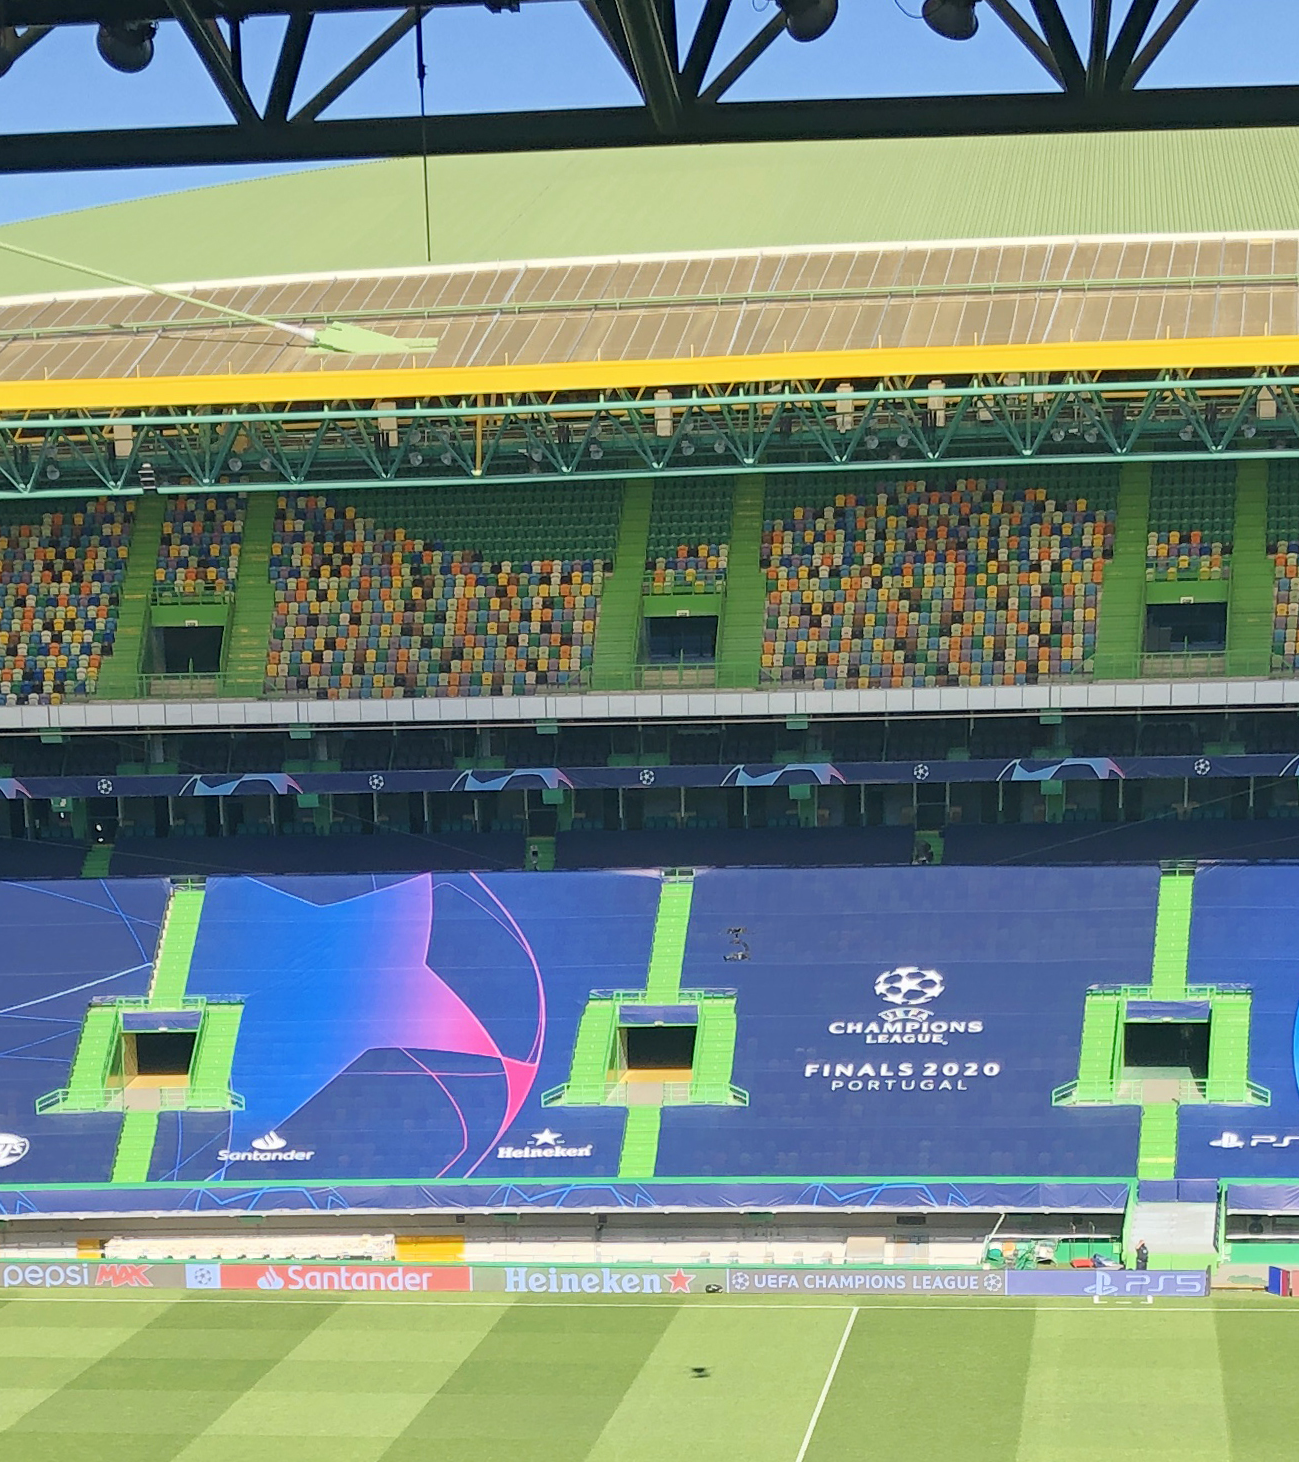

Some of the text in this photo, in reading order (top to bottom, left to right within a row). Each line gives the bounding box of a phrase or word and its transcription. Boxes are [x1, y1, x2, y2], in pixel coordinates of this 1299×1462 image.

[828, 1020, 984, 1034] CHAMPIONS
[865, 1034, 943, 1044] LEAGUE
[804, 1062, 1000, 1077] FINALS 2020
[831, 1079, 967, 1091] PORTUGAL
[217, 1150, 315, 1161] Santander
[497, 1146, 592, 1159] Heineken
[3, 1263, 154, 1288] pepsi MAX
[288, 1265, 433, 1291] Santander
[504, 1267, 662, 1294] Heineken
[754, 1274, 979, 1290] UEFA CHAMPIONS LEAGUE
[1125, 1275, 1201, 1292] PS5
